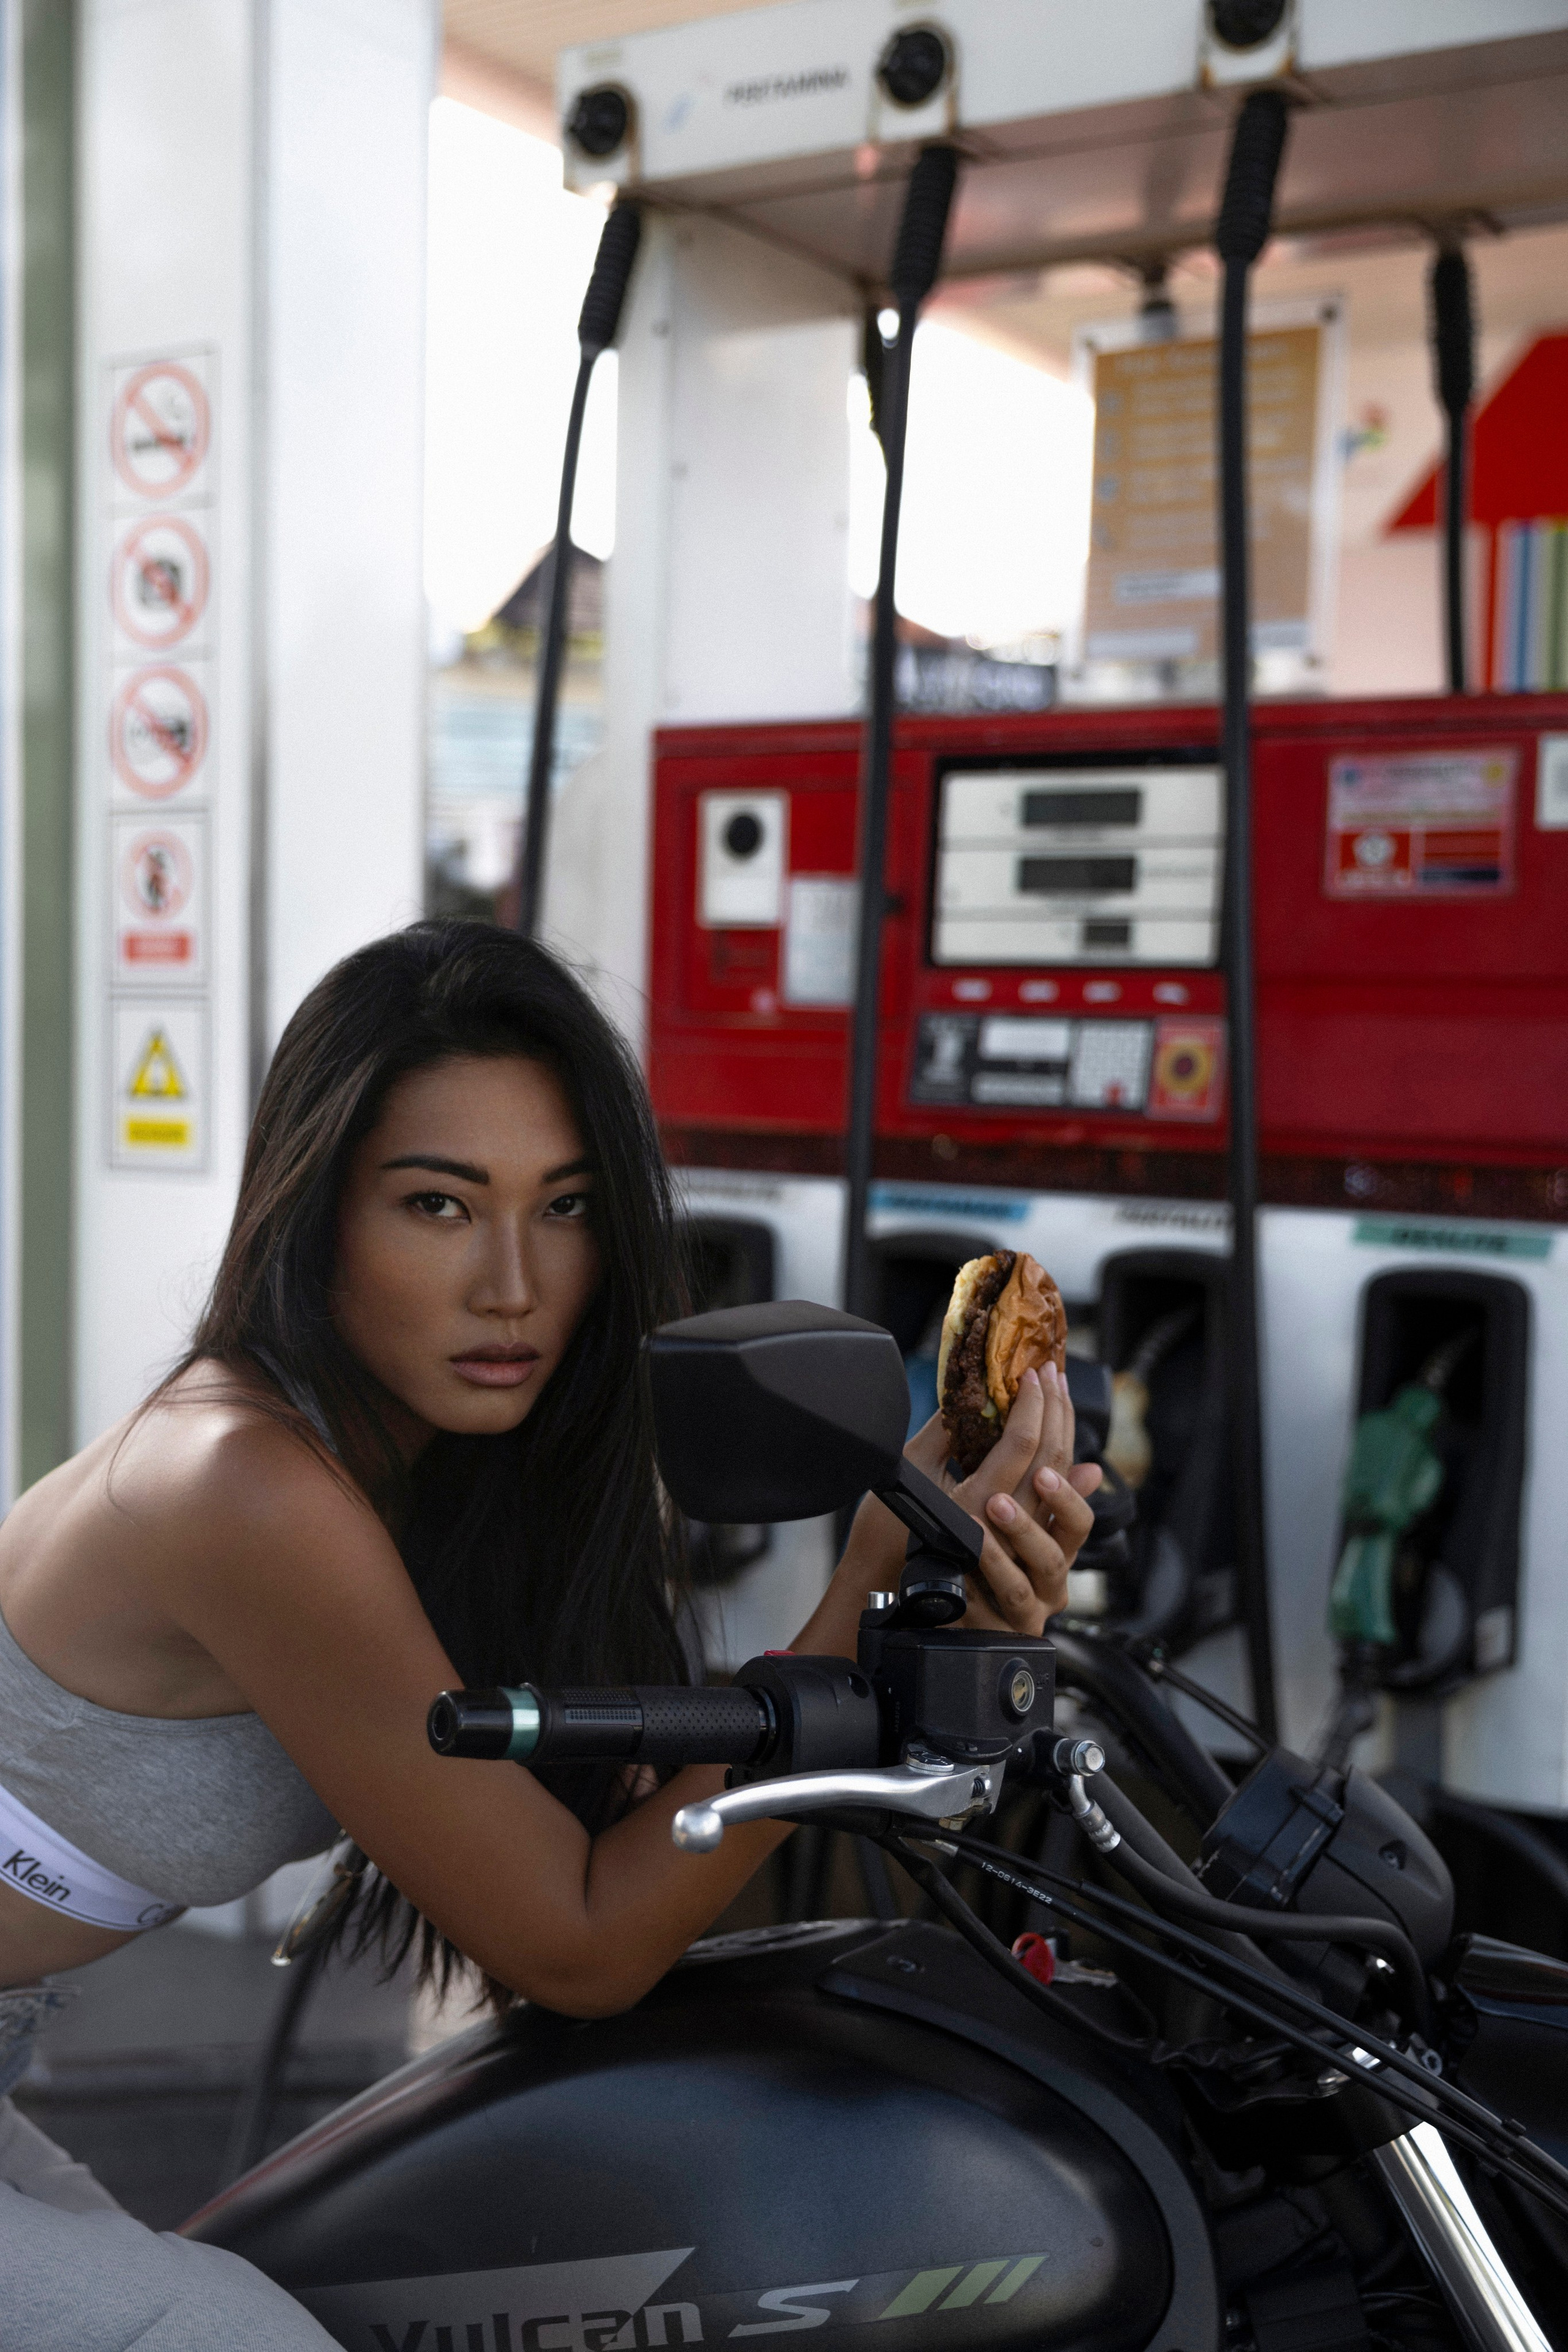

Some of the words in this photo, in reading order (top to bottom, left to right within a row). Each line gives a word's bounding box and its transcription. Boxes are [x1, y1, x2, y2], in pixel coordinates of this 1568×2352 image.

[3, 1849, 70, 1902] Klein
[981, 1861, 1053, 1904] 12-0614-3E22
[369, 2301, 704, 2352] Vulcan
[727, 2278, 860, 2338] S
